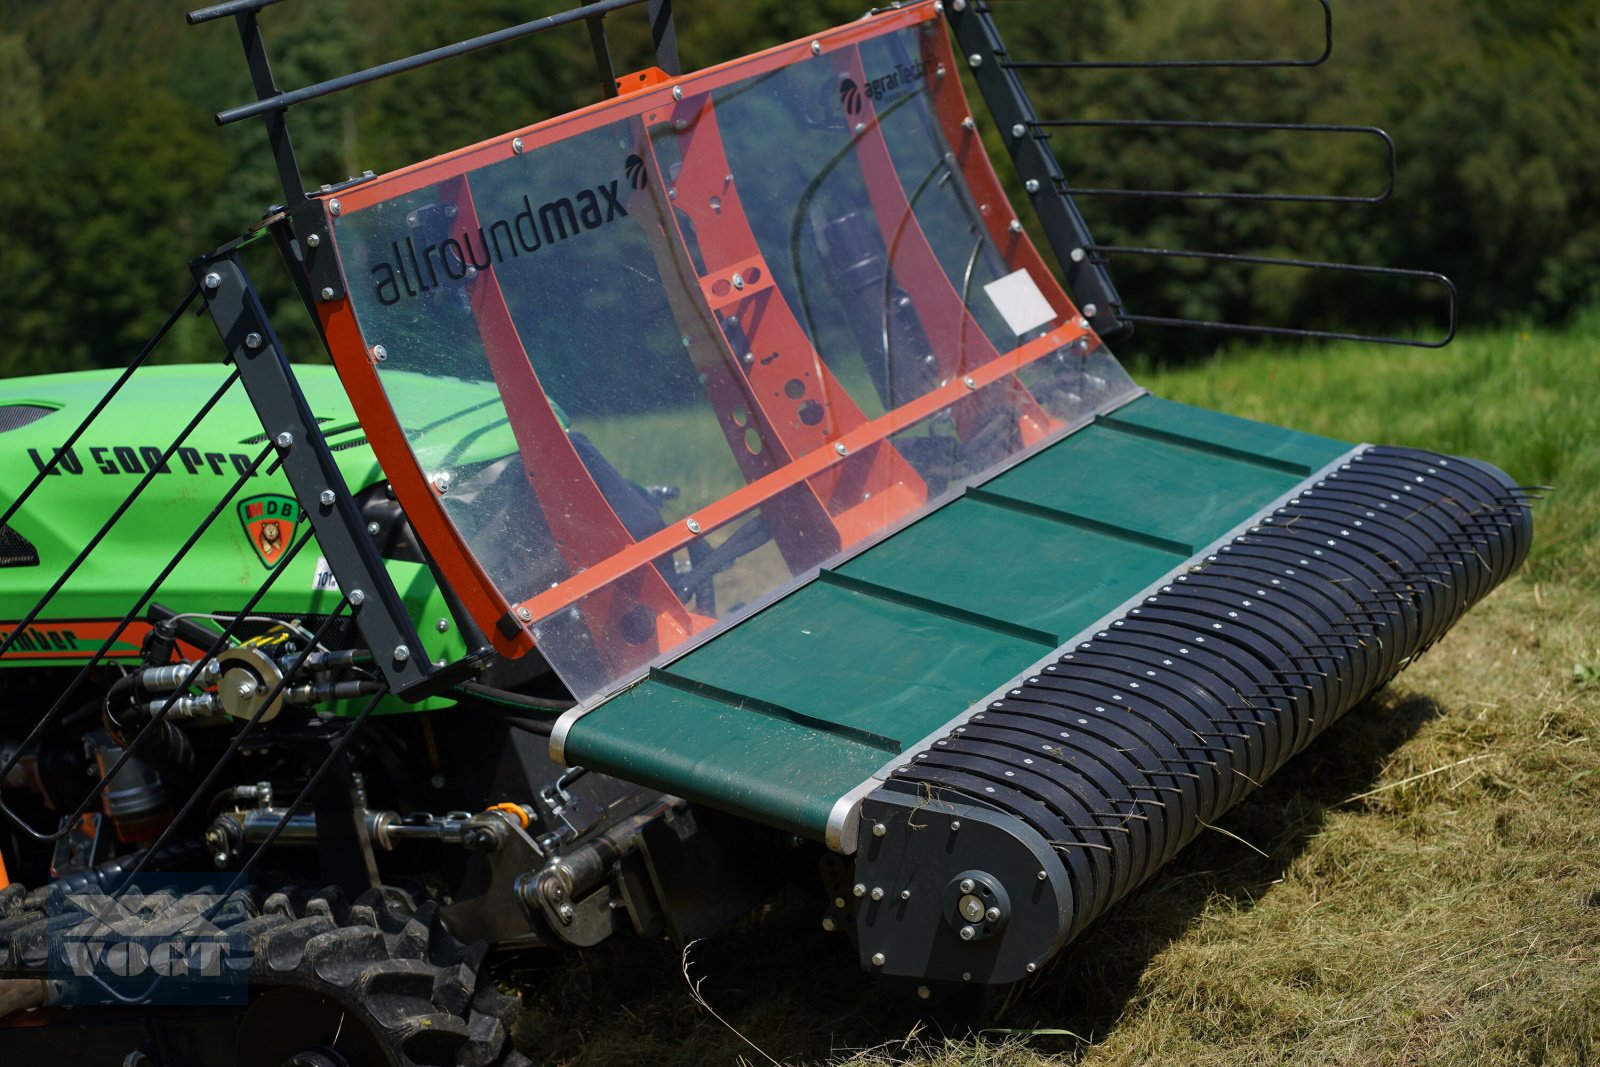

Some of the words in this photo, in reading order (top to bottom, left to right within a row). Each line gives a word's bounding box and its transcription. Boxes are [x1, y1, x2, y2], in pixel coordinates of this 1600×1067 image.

[371, 180, 628, 306] allroundmax
[27, 447, 84, 476] LV
[89, 446, 172, 475] 500
[177, 446, 259, 478] Pro
[245, 501, 292, 520] MDB
